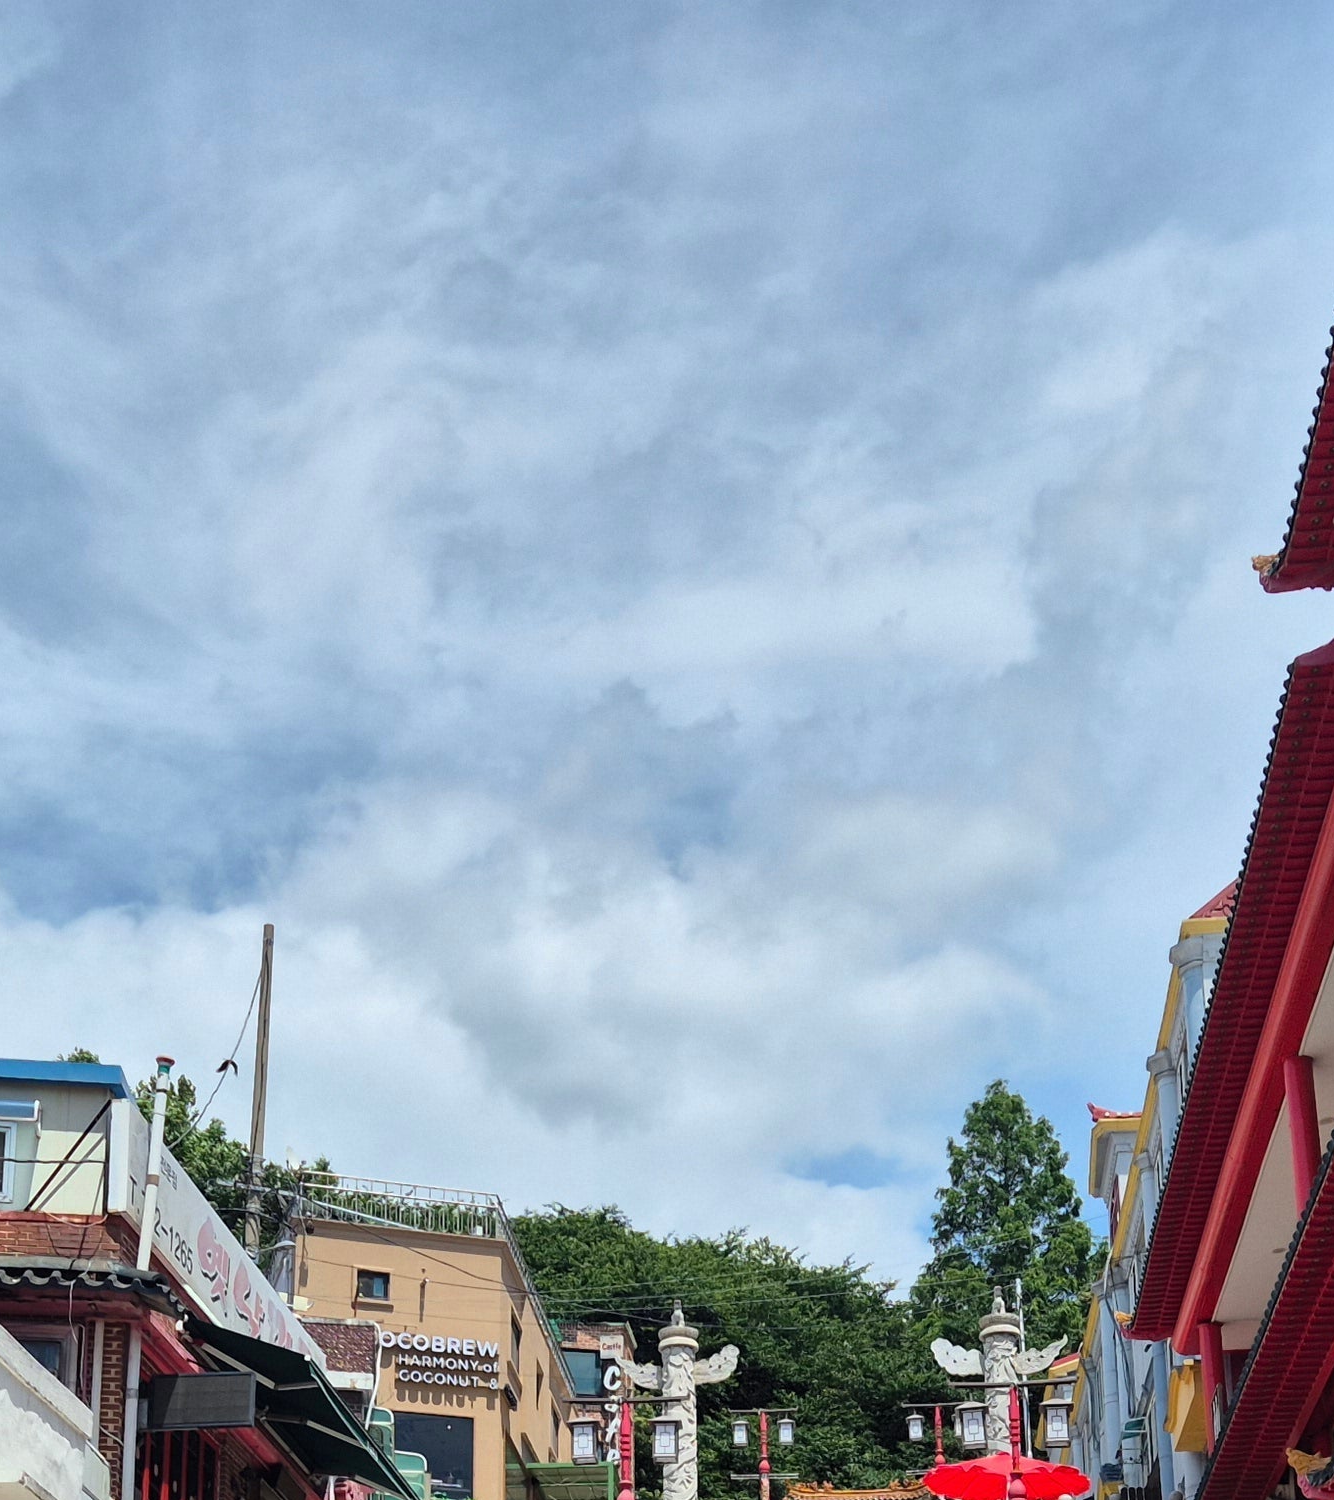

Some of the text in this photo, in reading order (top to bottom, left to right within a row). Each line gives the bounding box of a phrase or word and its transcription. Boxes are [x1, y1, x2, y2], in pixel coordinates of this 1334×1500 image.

[398, 1353, 499, 1374] HARMONY of
[399, 1369, 498, 1390] COCONUT &
